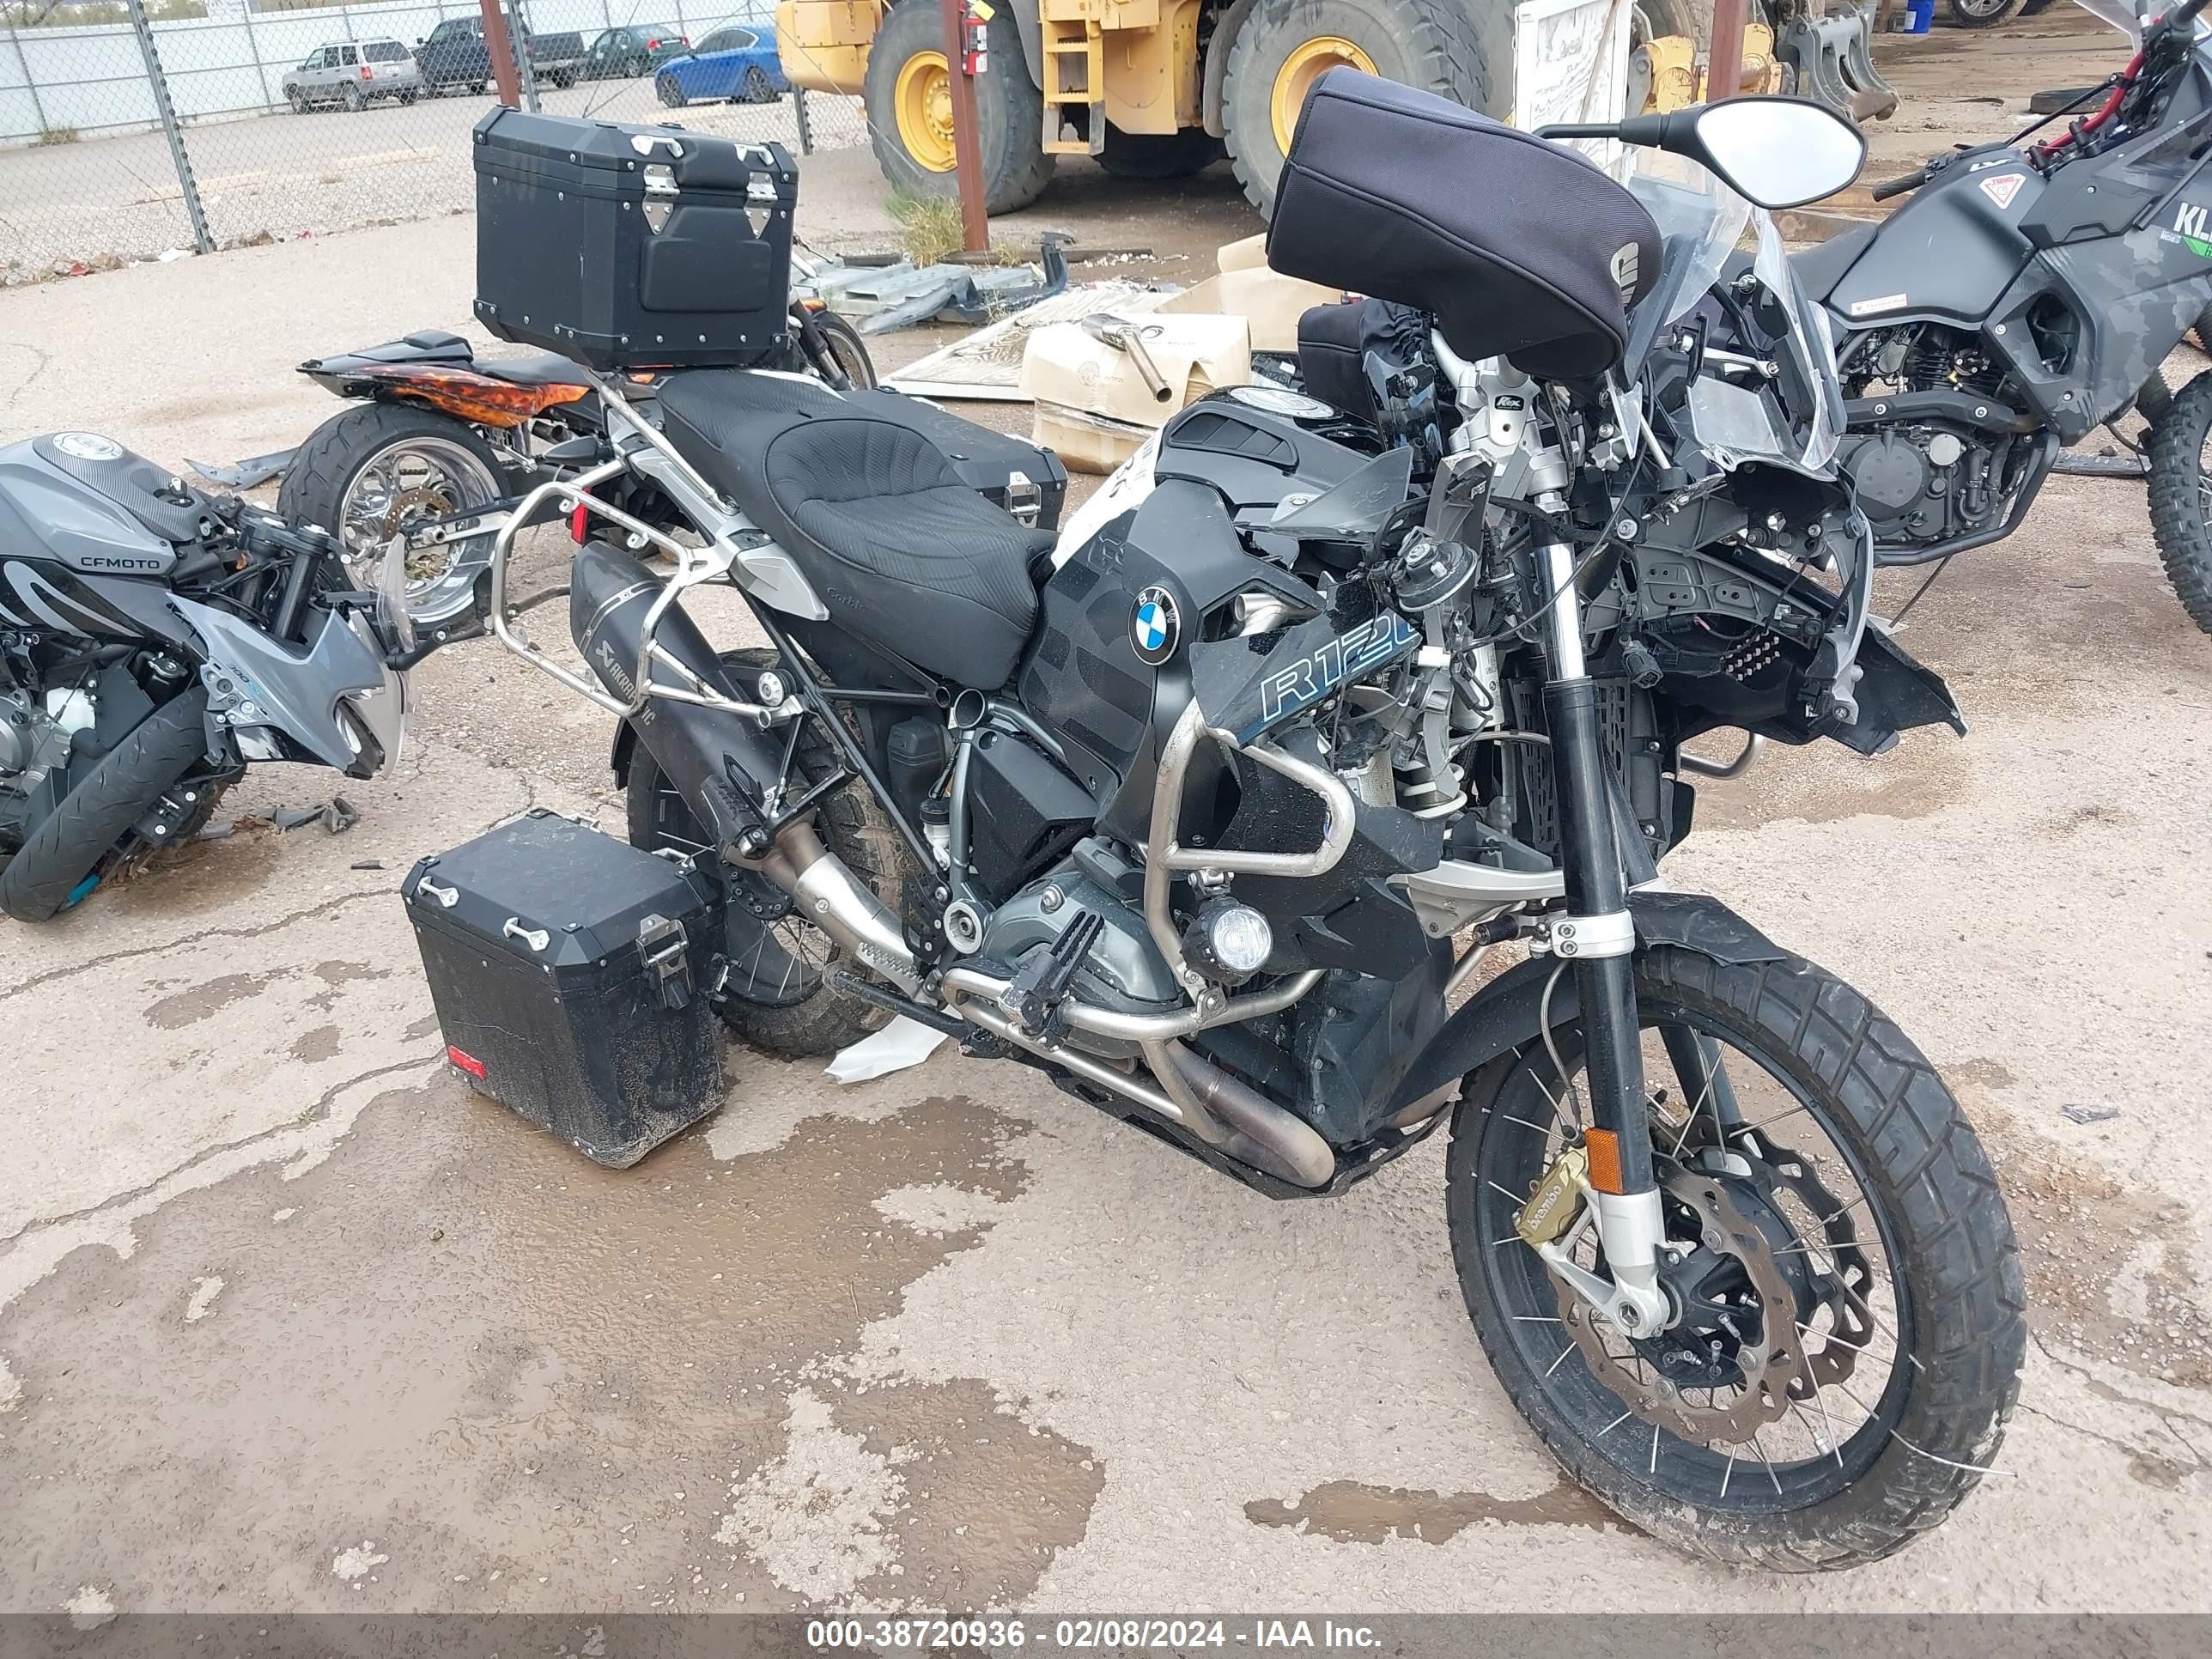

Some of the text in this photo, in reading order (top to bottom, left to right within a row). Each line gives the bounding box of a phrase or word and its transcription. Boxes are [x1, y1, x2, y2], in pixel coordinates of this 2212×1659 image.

[2173, 203, 2212, 243] KL
[81, 556, 161, 569] CFMOTO
[1138, 590, 1176, 624] BMW
[610, 663, 657, 726] AKRAIČ
[1527, 1185, 1563, 1231] brembo
